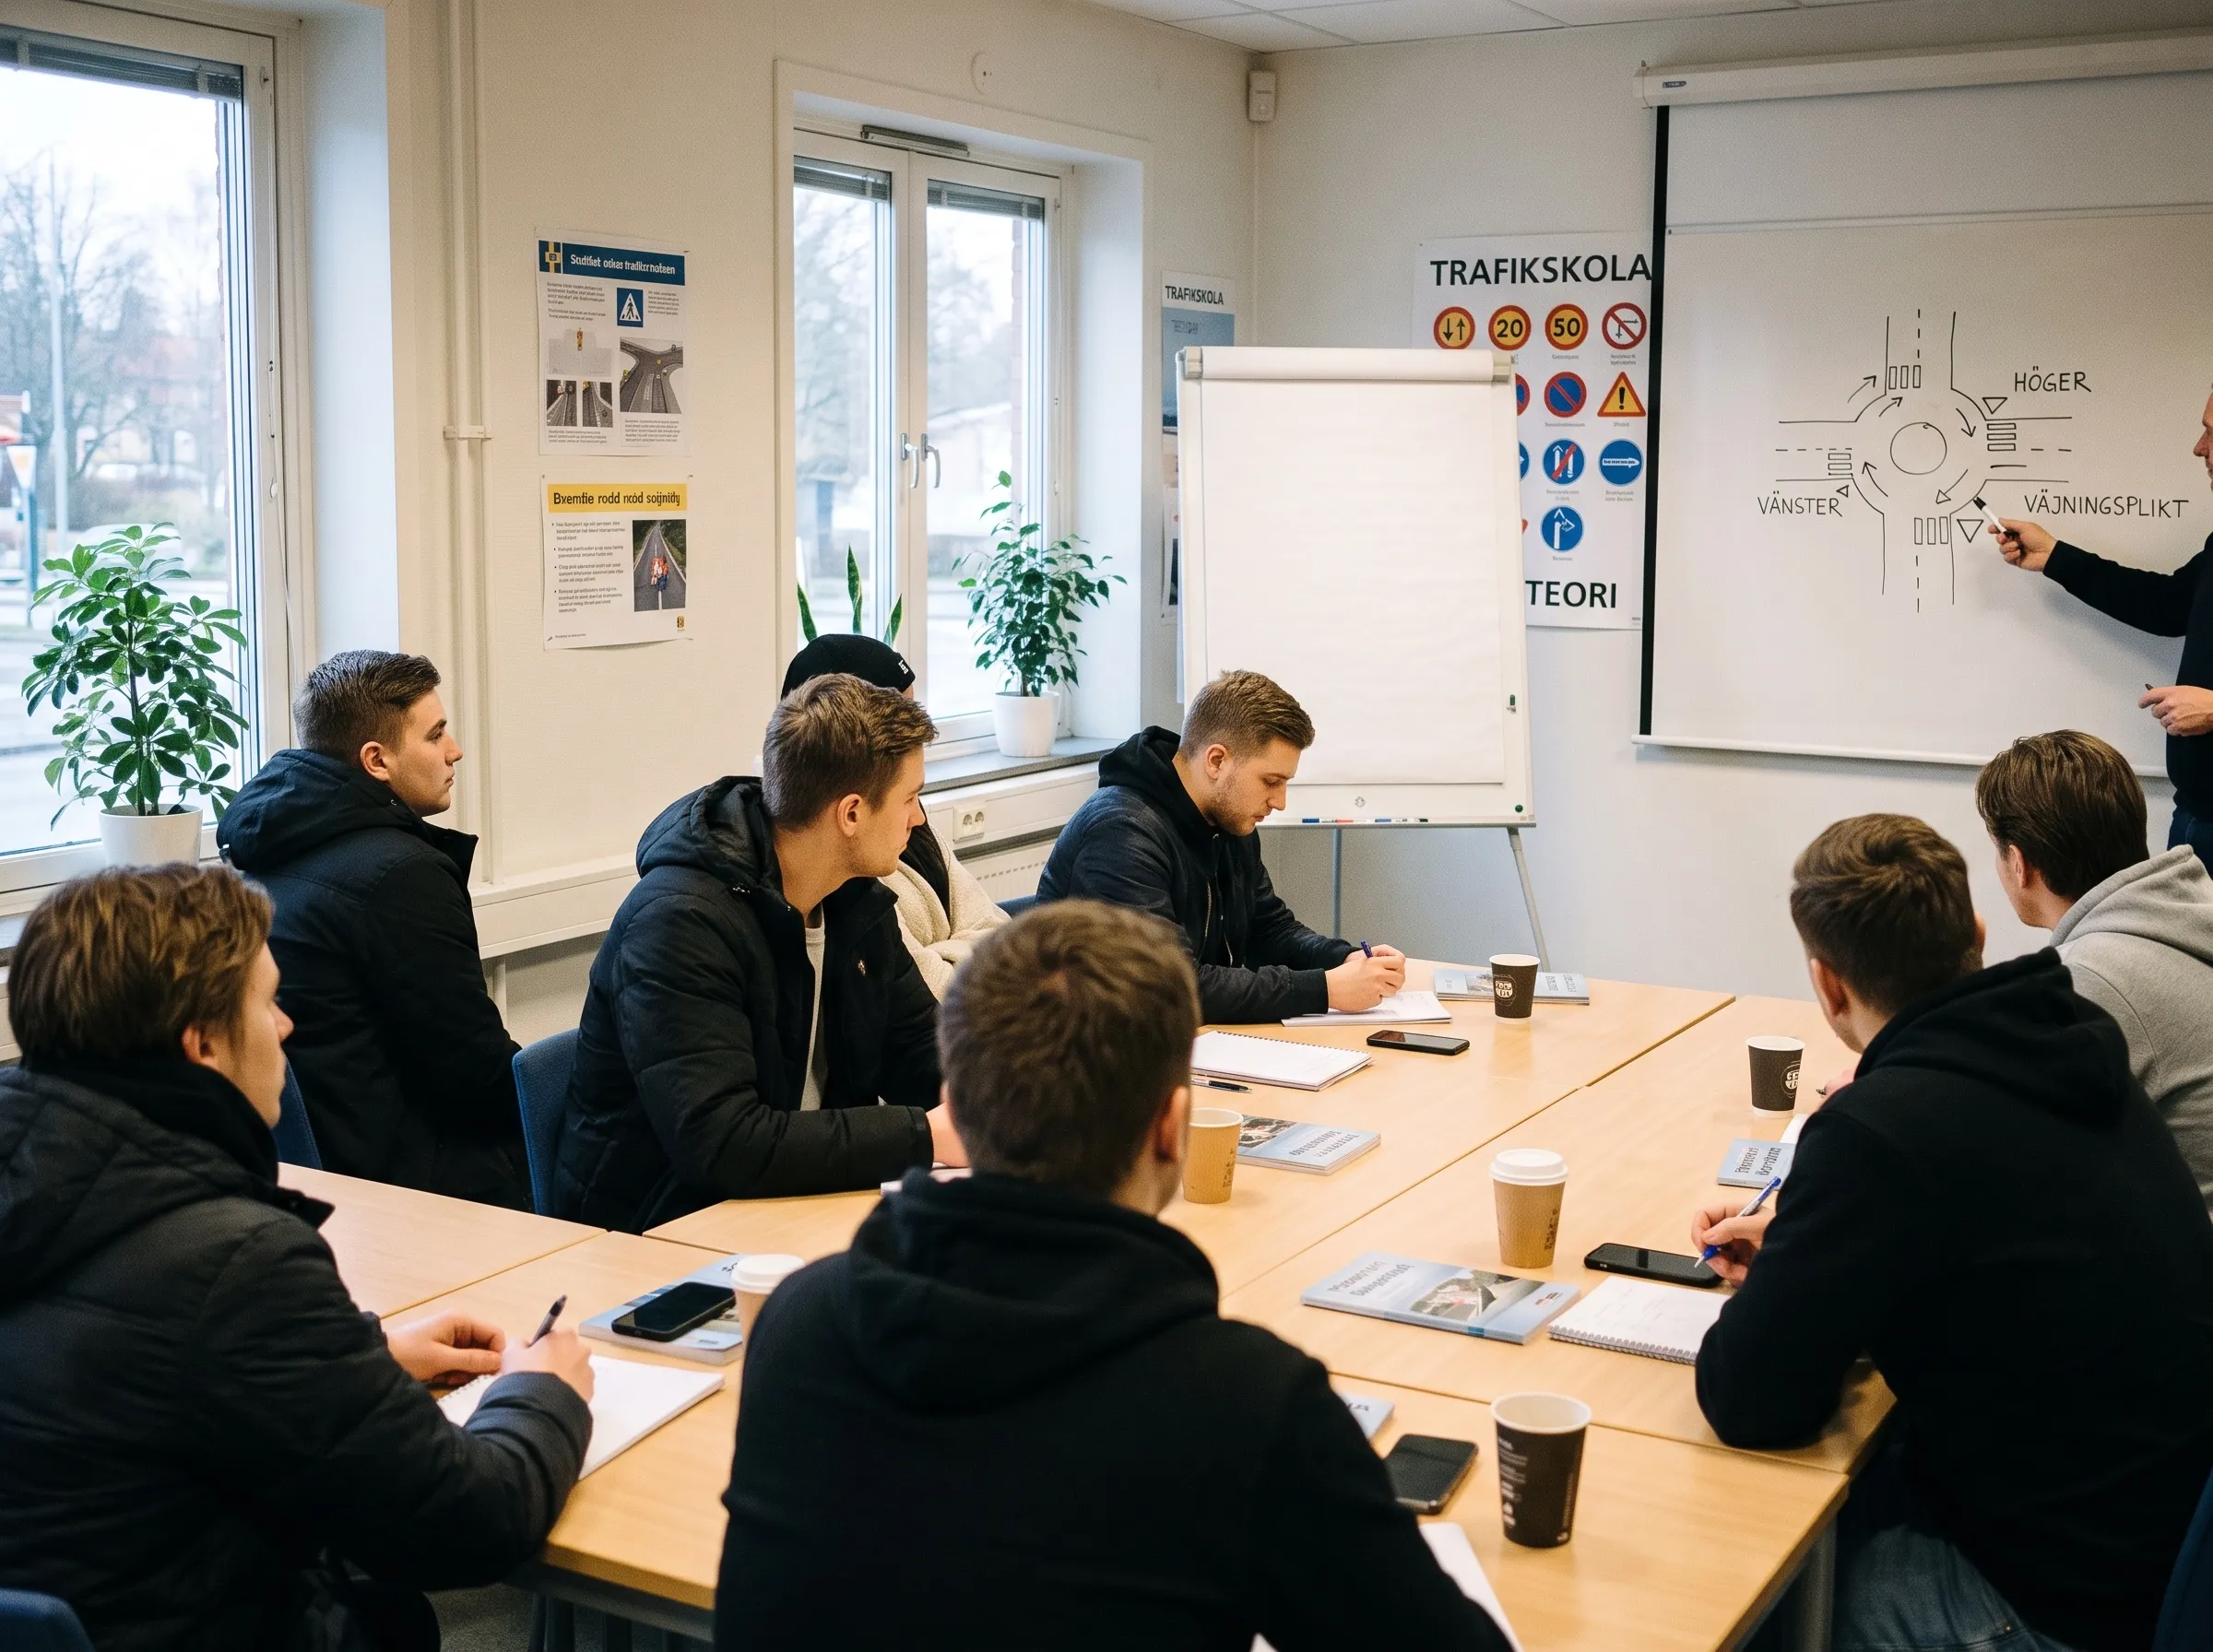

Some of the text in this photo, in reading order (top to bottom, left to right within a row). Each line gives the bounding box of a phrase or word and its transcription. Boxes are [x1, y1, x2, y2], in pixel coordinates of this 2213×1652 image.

[1430, 254, 1651, 287] TRAFIKSKOLA
[1165, 285, 1225, 305] TRAFIKSKOLA
[1497, 318, 1523, 338] 20
[1553, 317, 1580, 337] 50
[2014, 365, 2092, 393] HÖGER
[598, 491, 621, 504] rodd
[1757, 490, 1843, 518] VÄNSTER
[2024, 489, 2189, 519] VÄJNINGSPLIKT
[1525, 580, 1617, 608] TEORI
